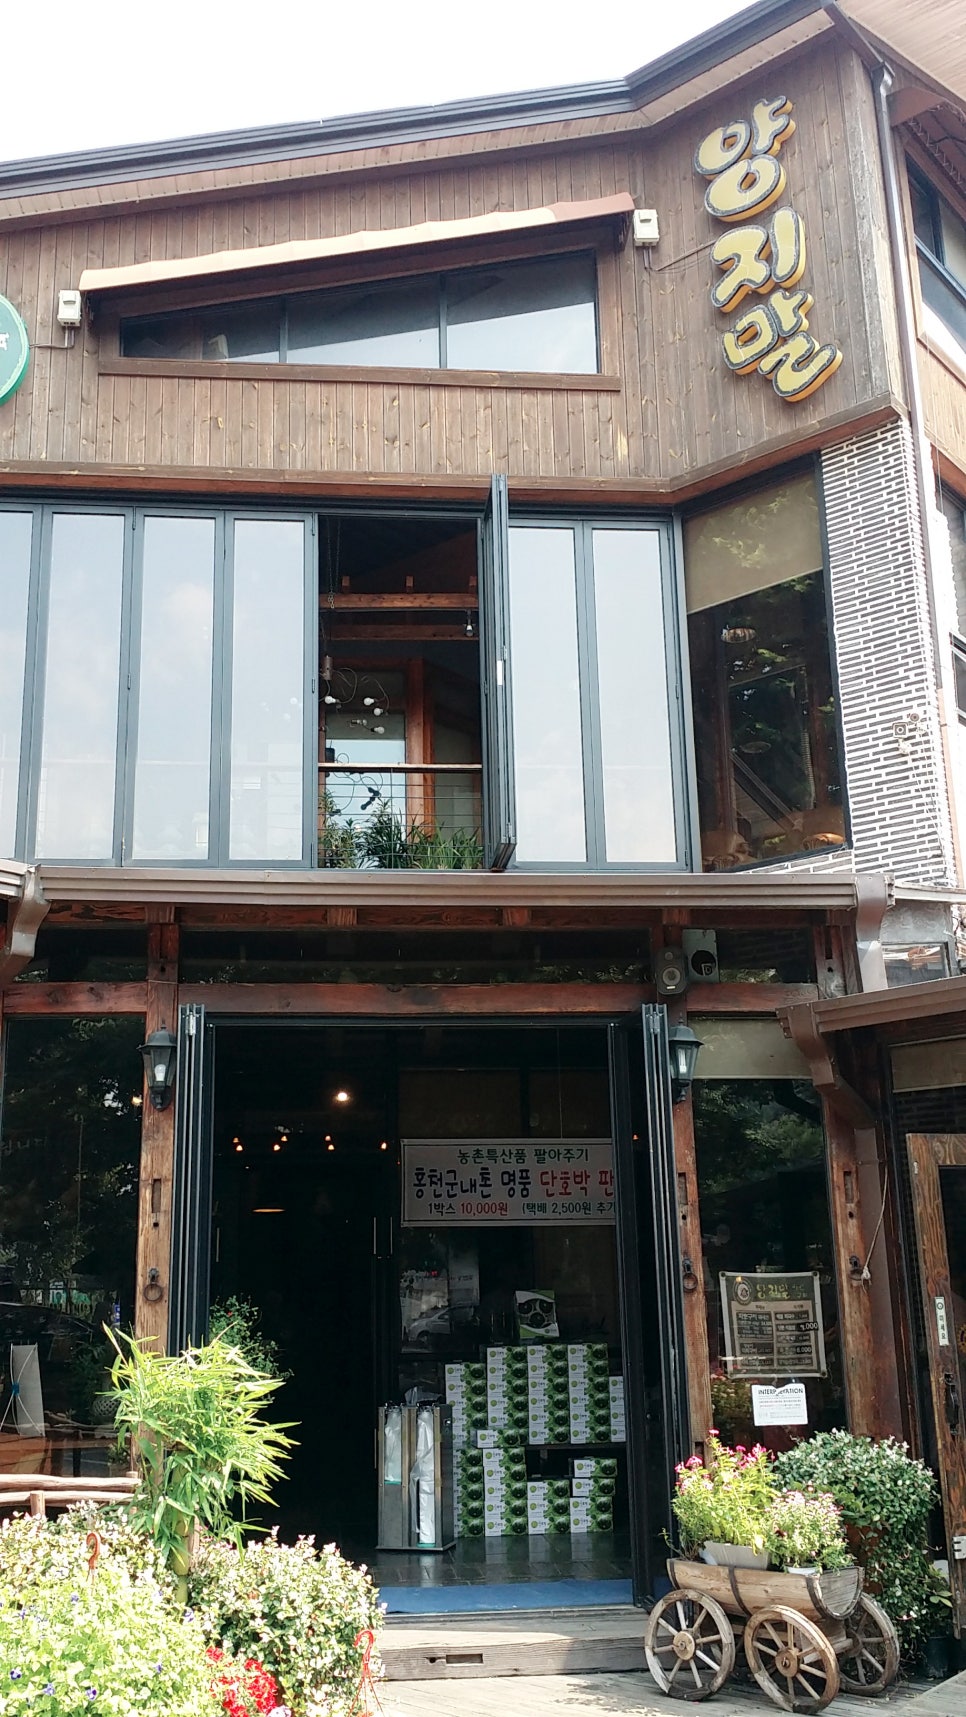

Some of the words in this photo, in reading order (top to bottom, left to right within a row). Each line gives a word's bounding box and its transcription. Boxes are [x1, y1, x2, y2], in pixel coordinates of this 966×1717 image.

[694, 95, 843, 402] 양지말
[457, 1148, 527, 1164] 농촌특산품
[533, 1148, 589, 1164] 팔아주기
[413, 1166, 493, 1199] 홍천군내촌
[501, 1168, 532, 1198] 명품
[540, 1169, 591, 1198] 단호박
[428, 1202, 456, 1215] 1박스
[460, 1202, 508, 1216] 10,000원
[551, 1202, 591, 1216] 2,500원
